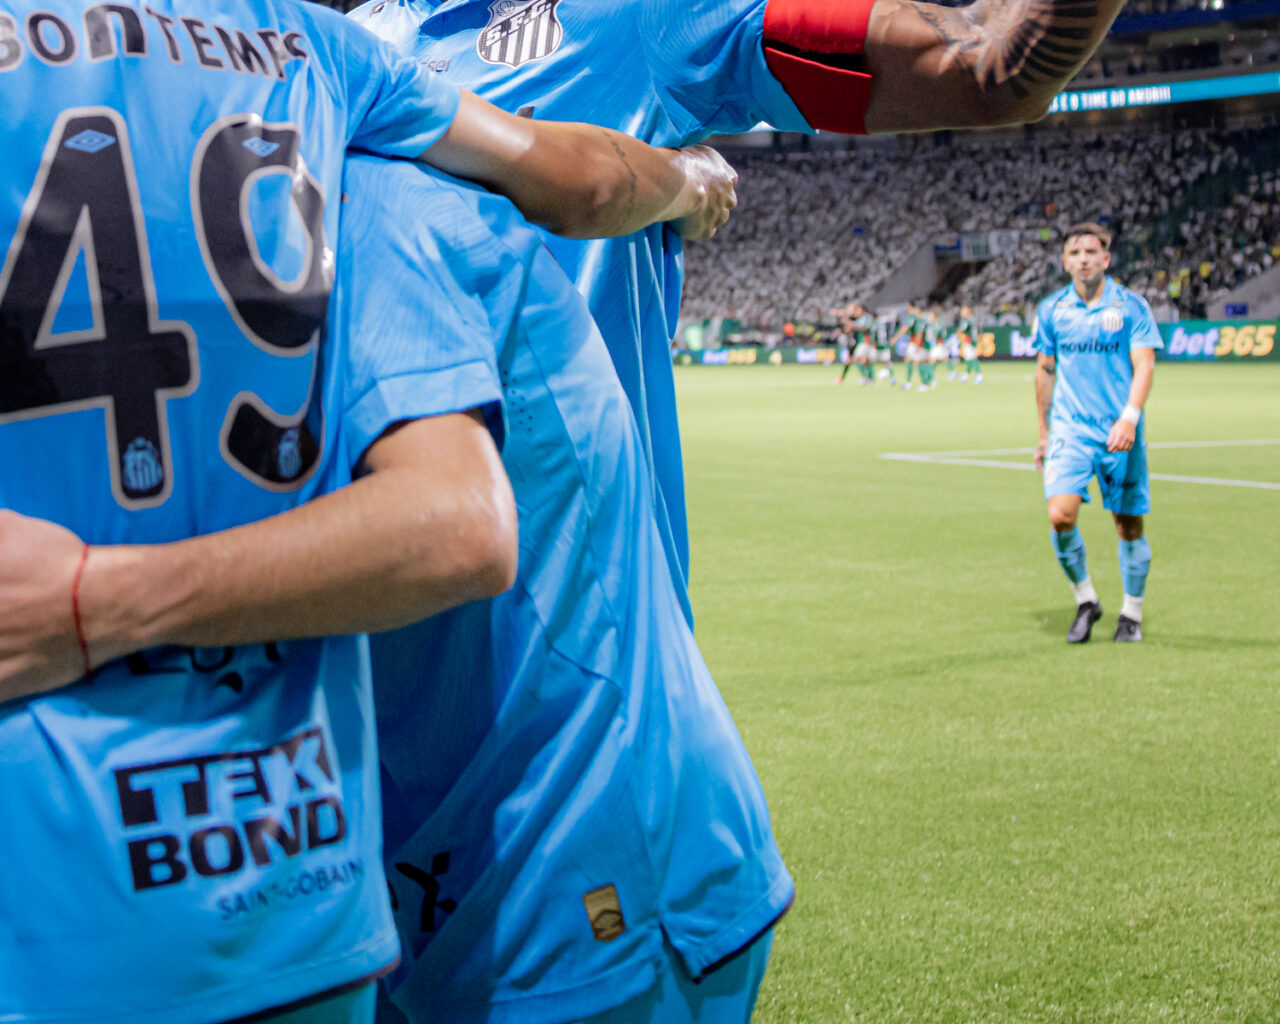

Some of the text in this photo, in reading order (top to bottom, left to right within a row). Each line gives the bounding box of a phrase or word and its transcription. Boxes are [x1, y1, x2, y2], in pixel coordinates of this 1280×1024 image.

[1081, 92, 1108, 109] TIME
[1168, 325, 1277, 357] bet365
[114, 725, 334, 827] TEK
[128, 795, 347, 892] BOND
